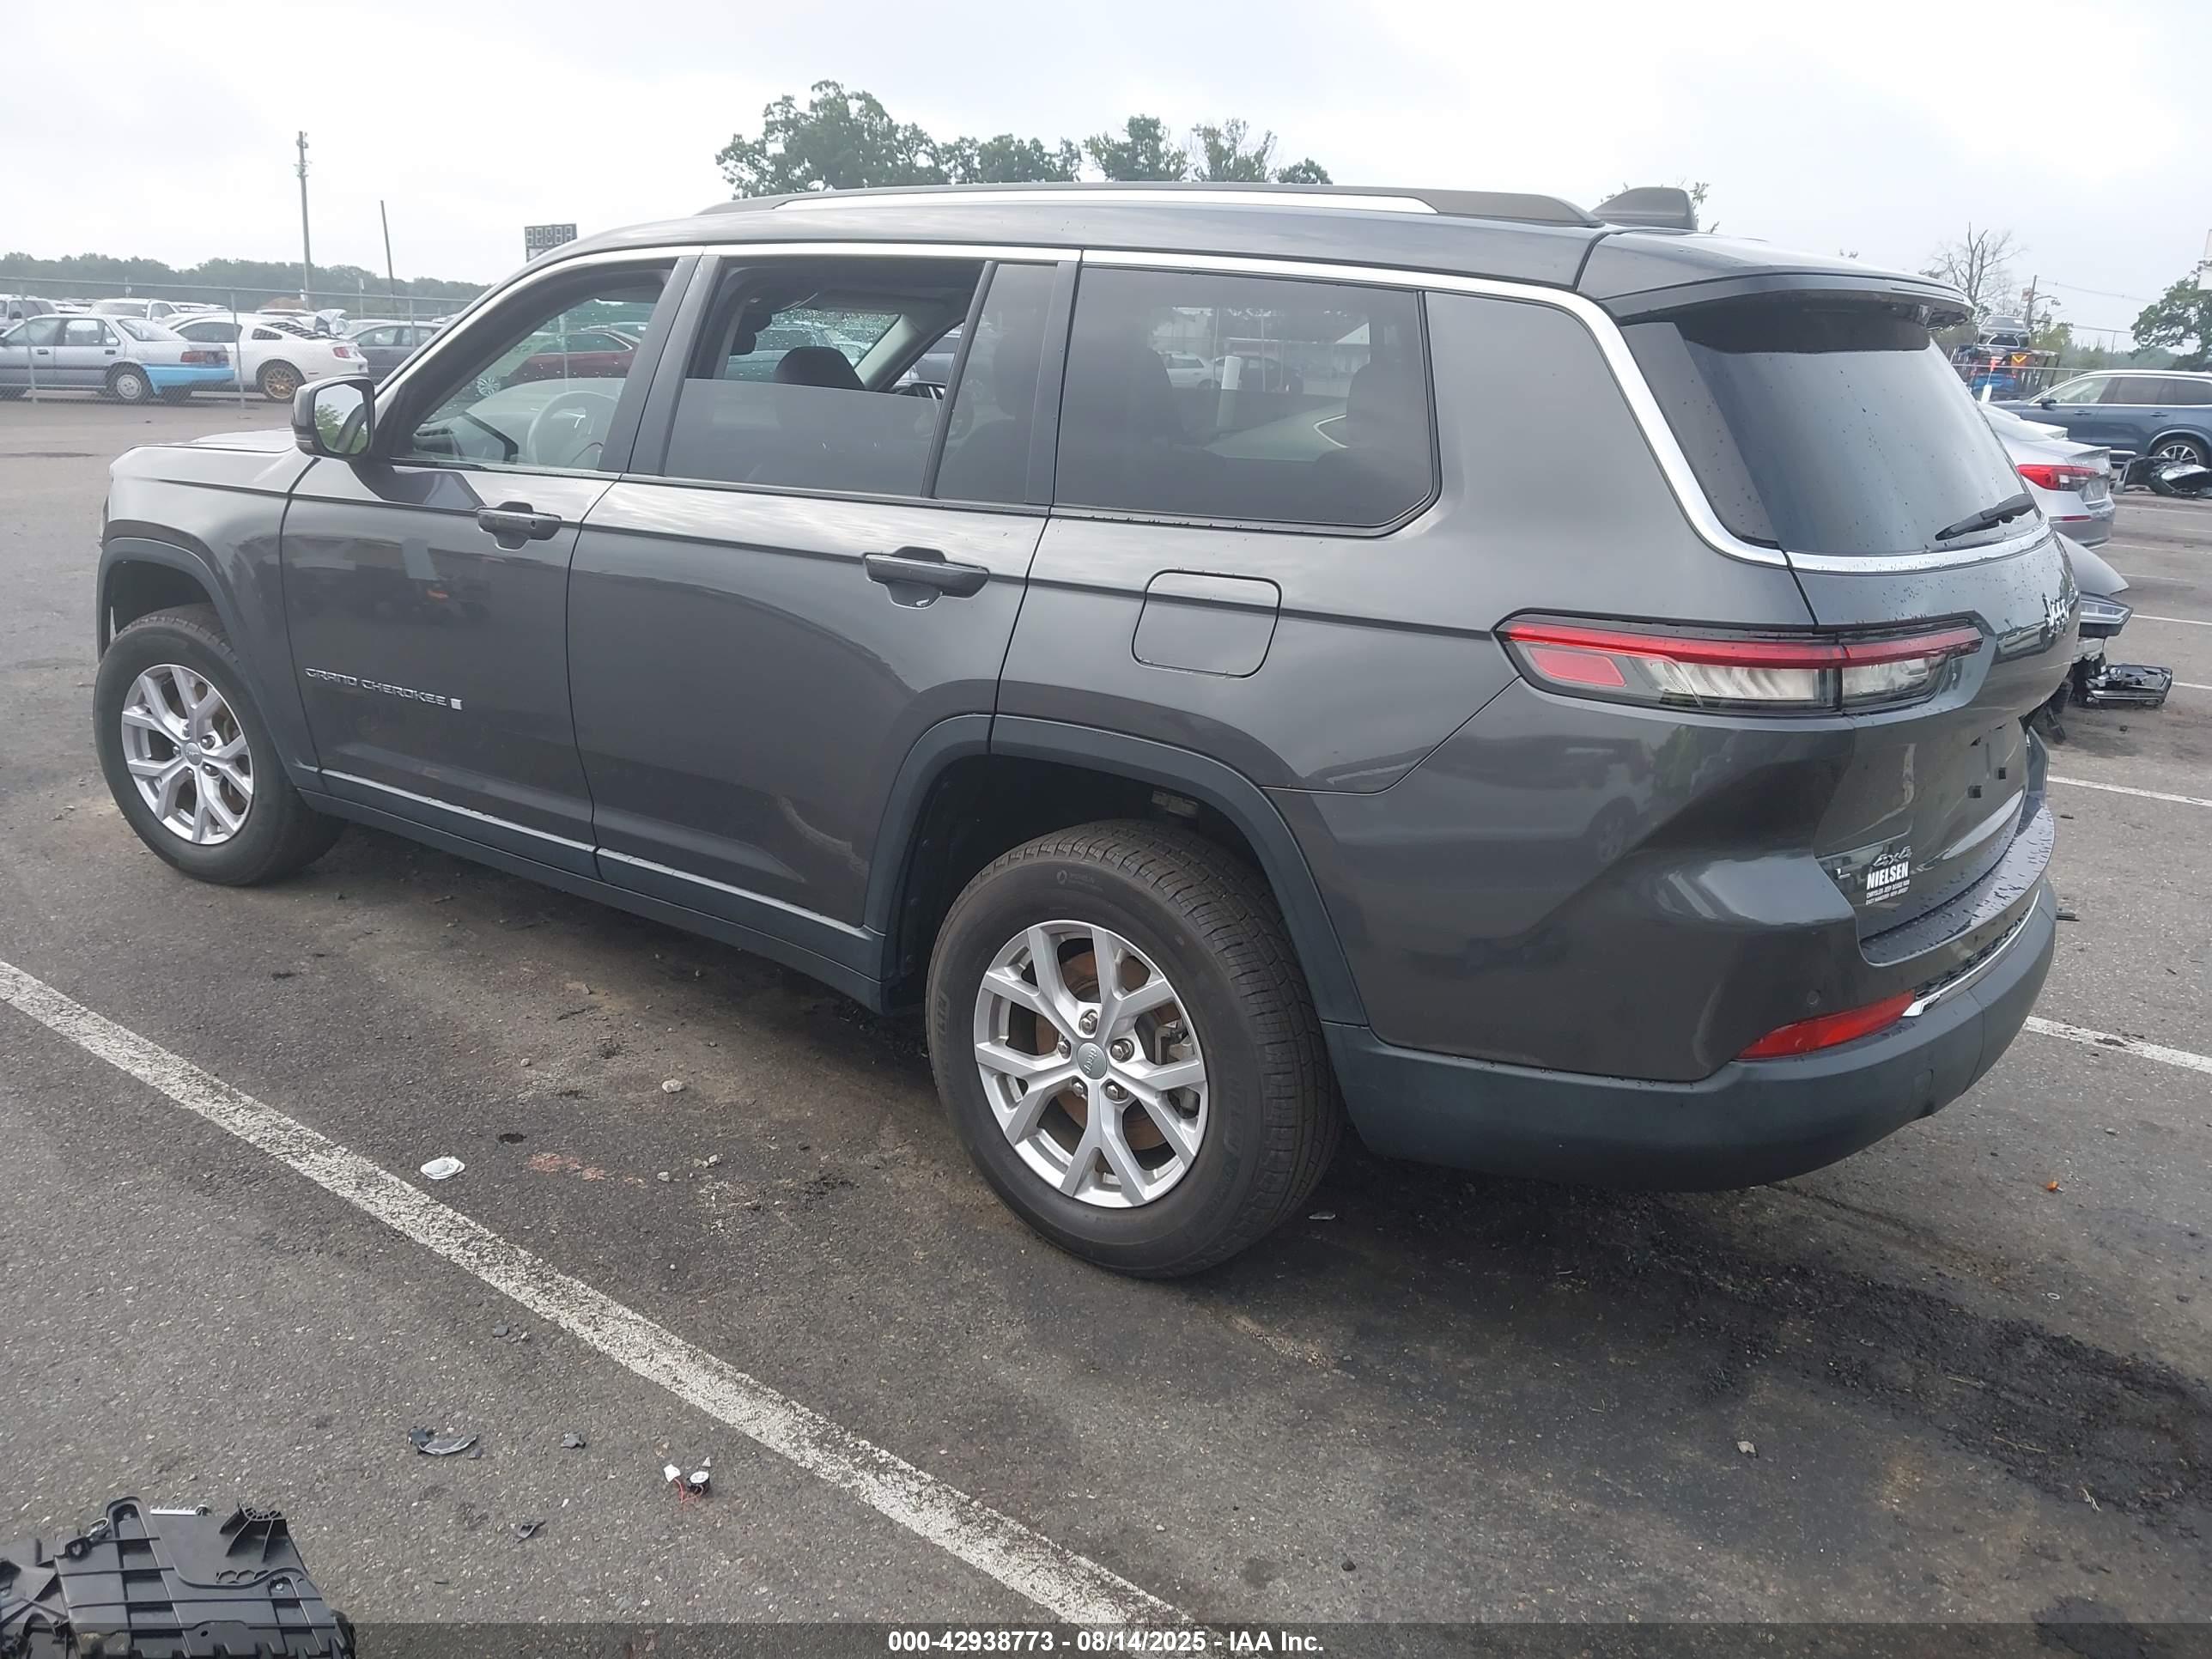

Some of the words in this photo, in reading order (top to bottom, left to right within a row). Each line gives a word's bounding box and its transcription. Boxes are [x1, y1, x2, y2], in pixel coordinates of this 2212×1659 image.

[304, 667, 358, 686] GRAND
[361, 679, 447, 707] CHEROKEE
[1866, 860, 1909, 890] NIELSEN
